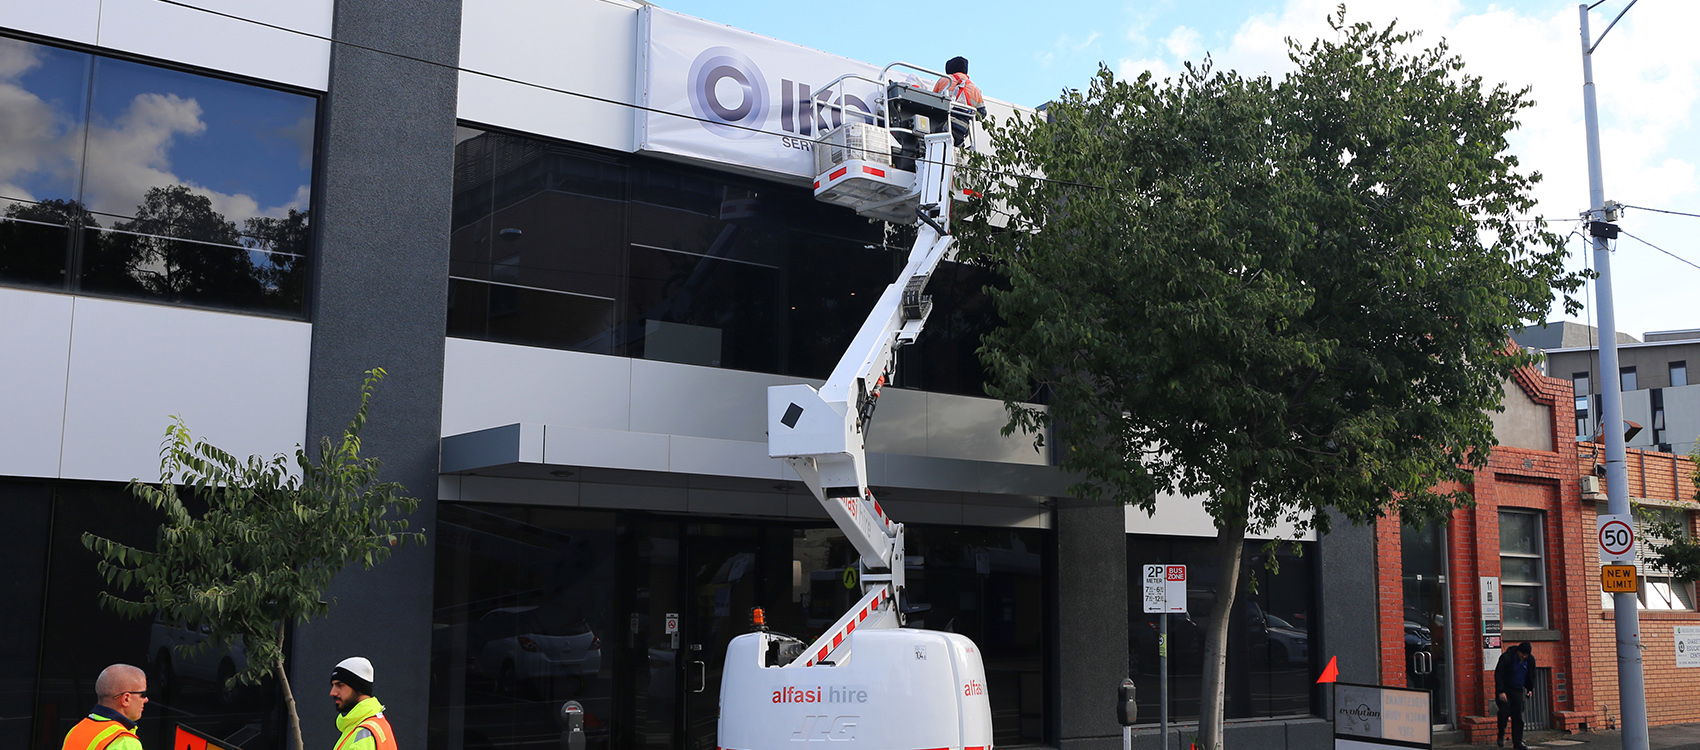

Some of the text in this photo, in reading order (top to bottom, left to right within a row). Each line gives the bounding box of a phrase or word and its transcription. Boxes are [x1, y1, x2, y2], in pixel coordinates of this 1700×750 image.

[1604, 529, 1628, 547] 50
[1147, 566, 1163, 578] 2P
[1607, 569, 1631, 578] NEW
[1606, 579, 1632, 589] LIMIT
[772, 686, 868, 703] alfasi hire
[1339, 705, 1382, 719] evolution
